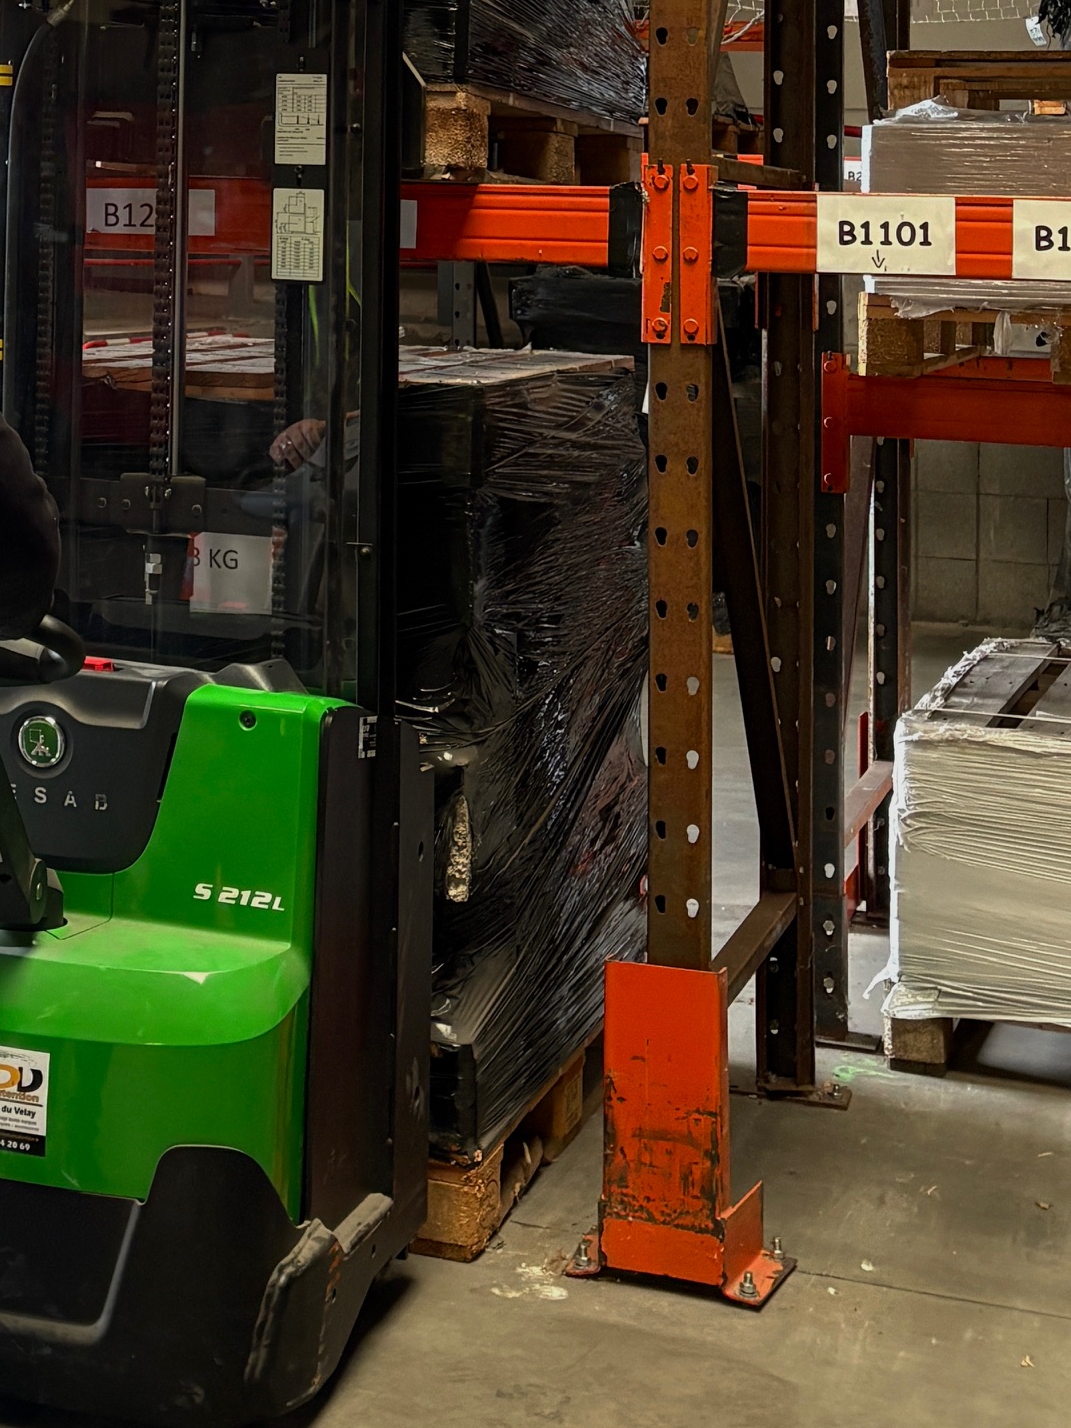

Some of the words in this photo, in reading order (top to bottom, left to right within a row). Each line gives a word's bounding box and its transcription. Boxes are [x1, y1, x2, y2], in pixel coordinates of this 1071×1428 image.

[103, 202, 155, 228] B12
[837, 220, 933, 247] B1101
[209, 548, 239, 570] KG
[217, 886, 285, 911] 212L
[1, 1105, 13, 1114] du
[14, 1106, 37, 1119] Velay
